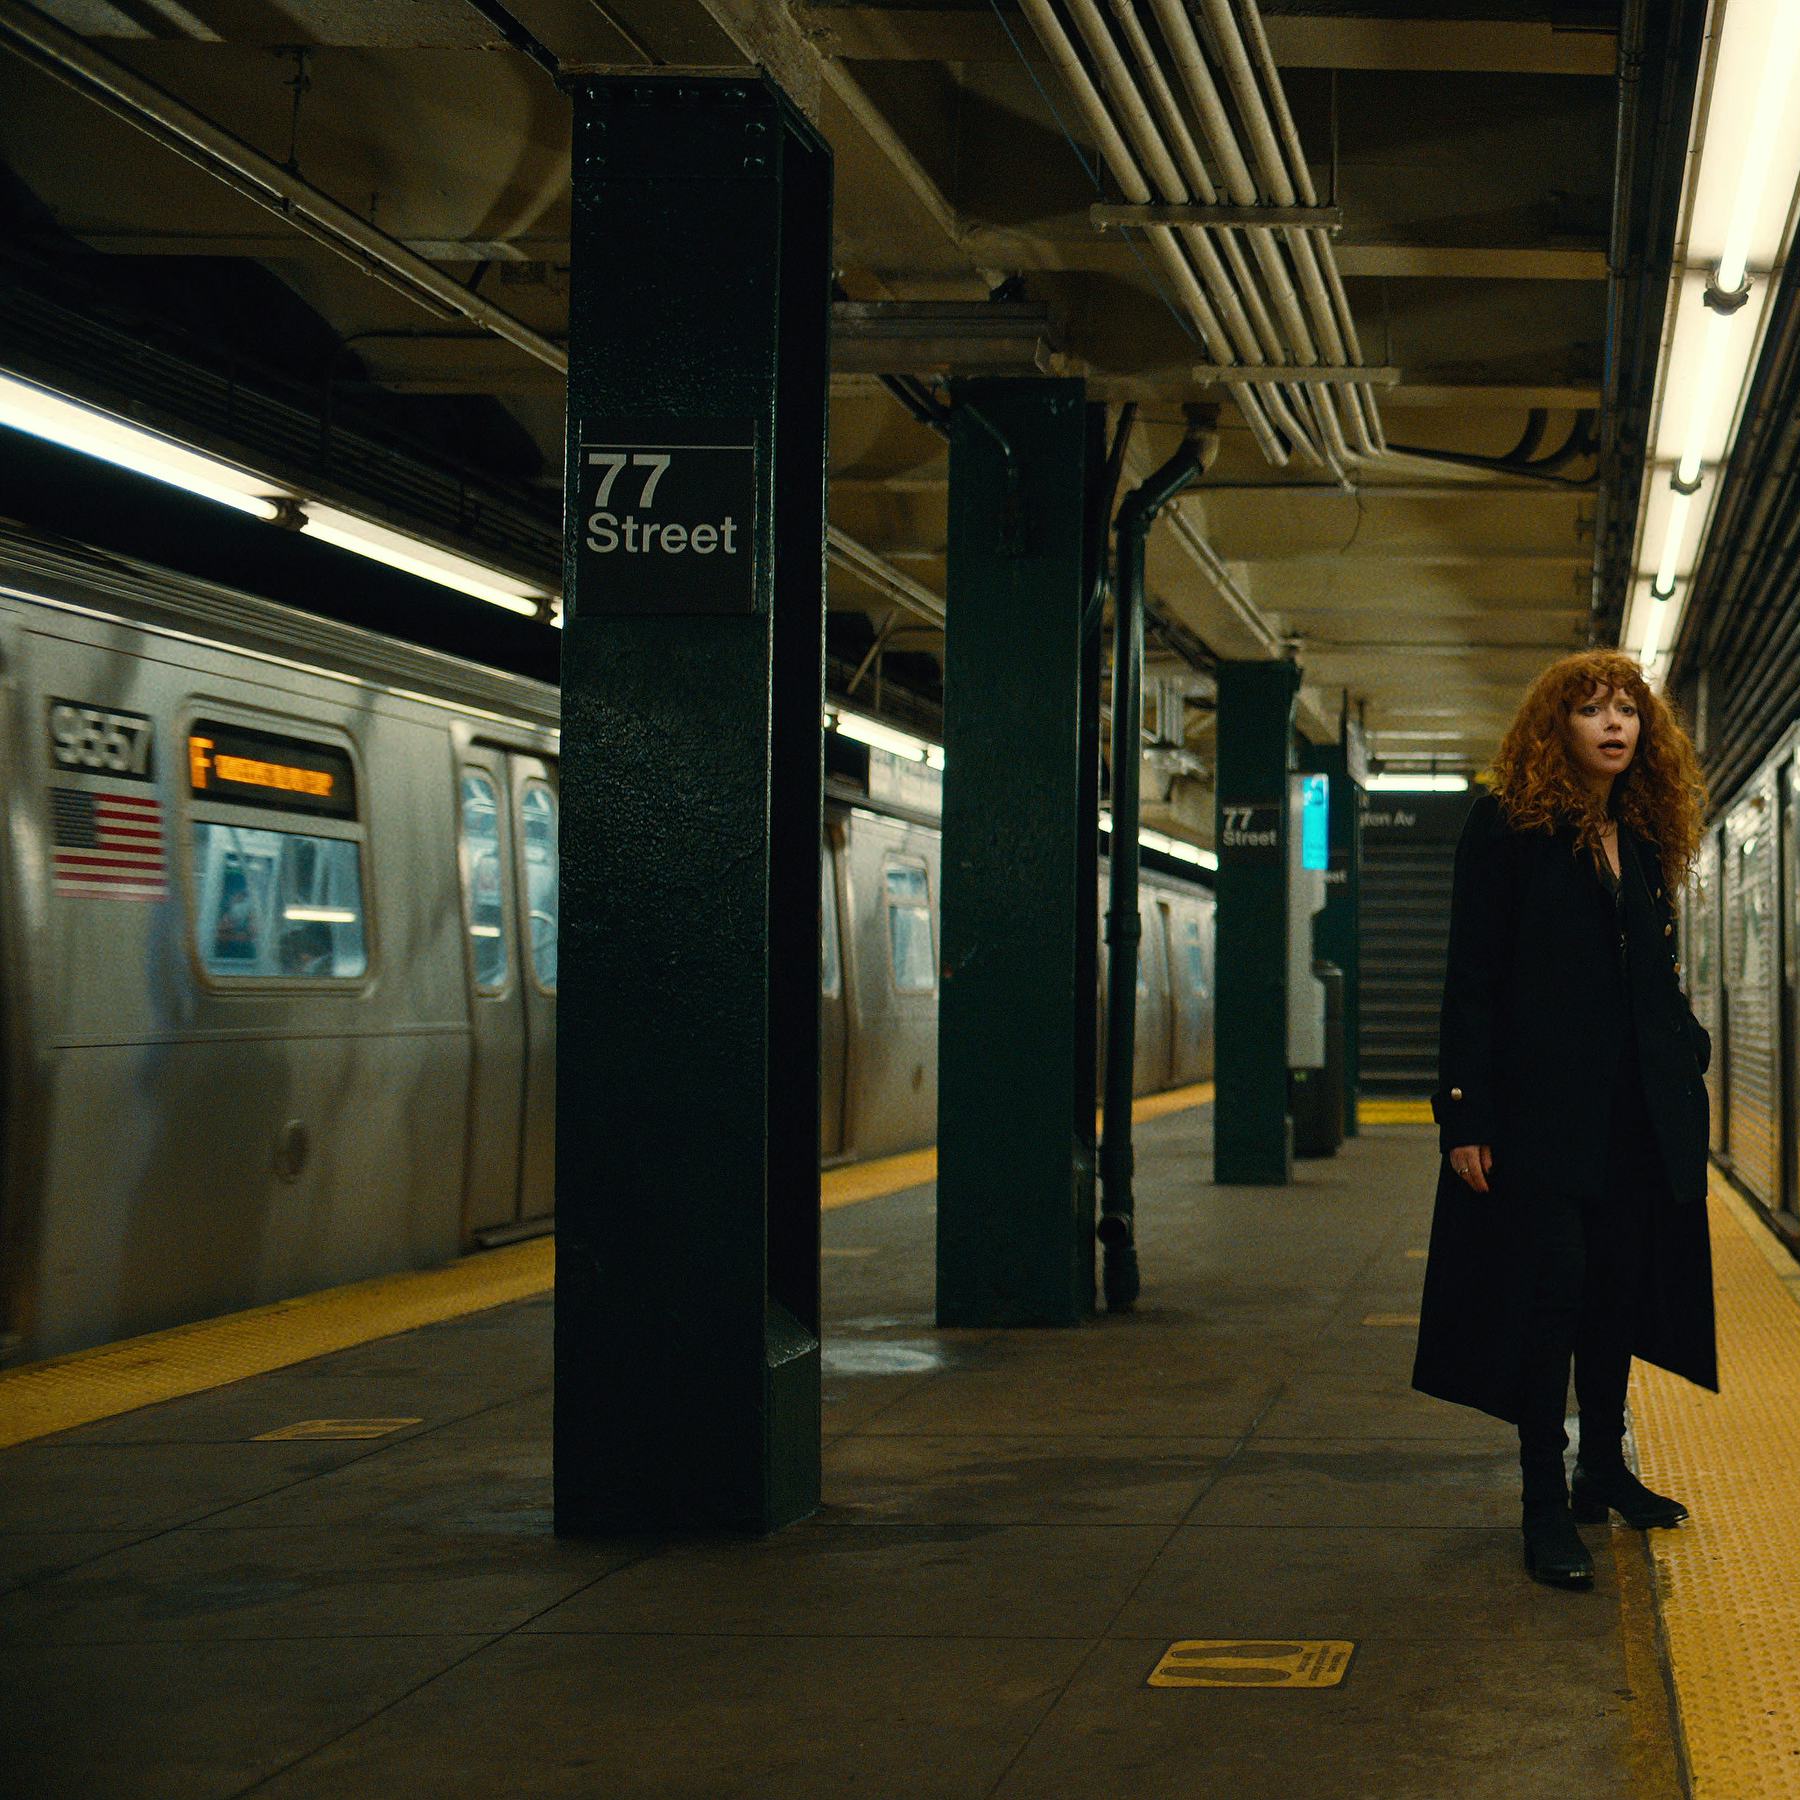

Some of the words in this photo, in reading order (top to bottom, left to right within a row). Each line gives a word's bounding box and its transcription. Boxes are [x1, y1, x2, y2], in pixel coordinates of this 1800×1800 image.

[588, 453, 671, 508] 77
[586, 512, 737, 554] Street
[189, 735, 215, 789] F
[1222, 806, 1253, 831] 77
[1222, 829, 1278, 847] Street
